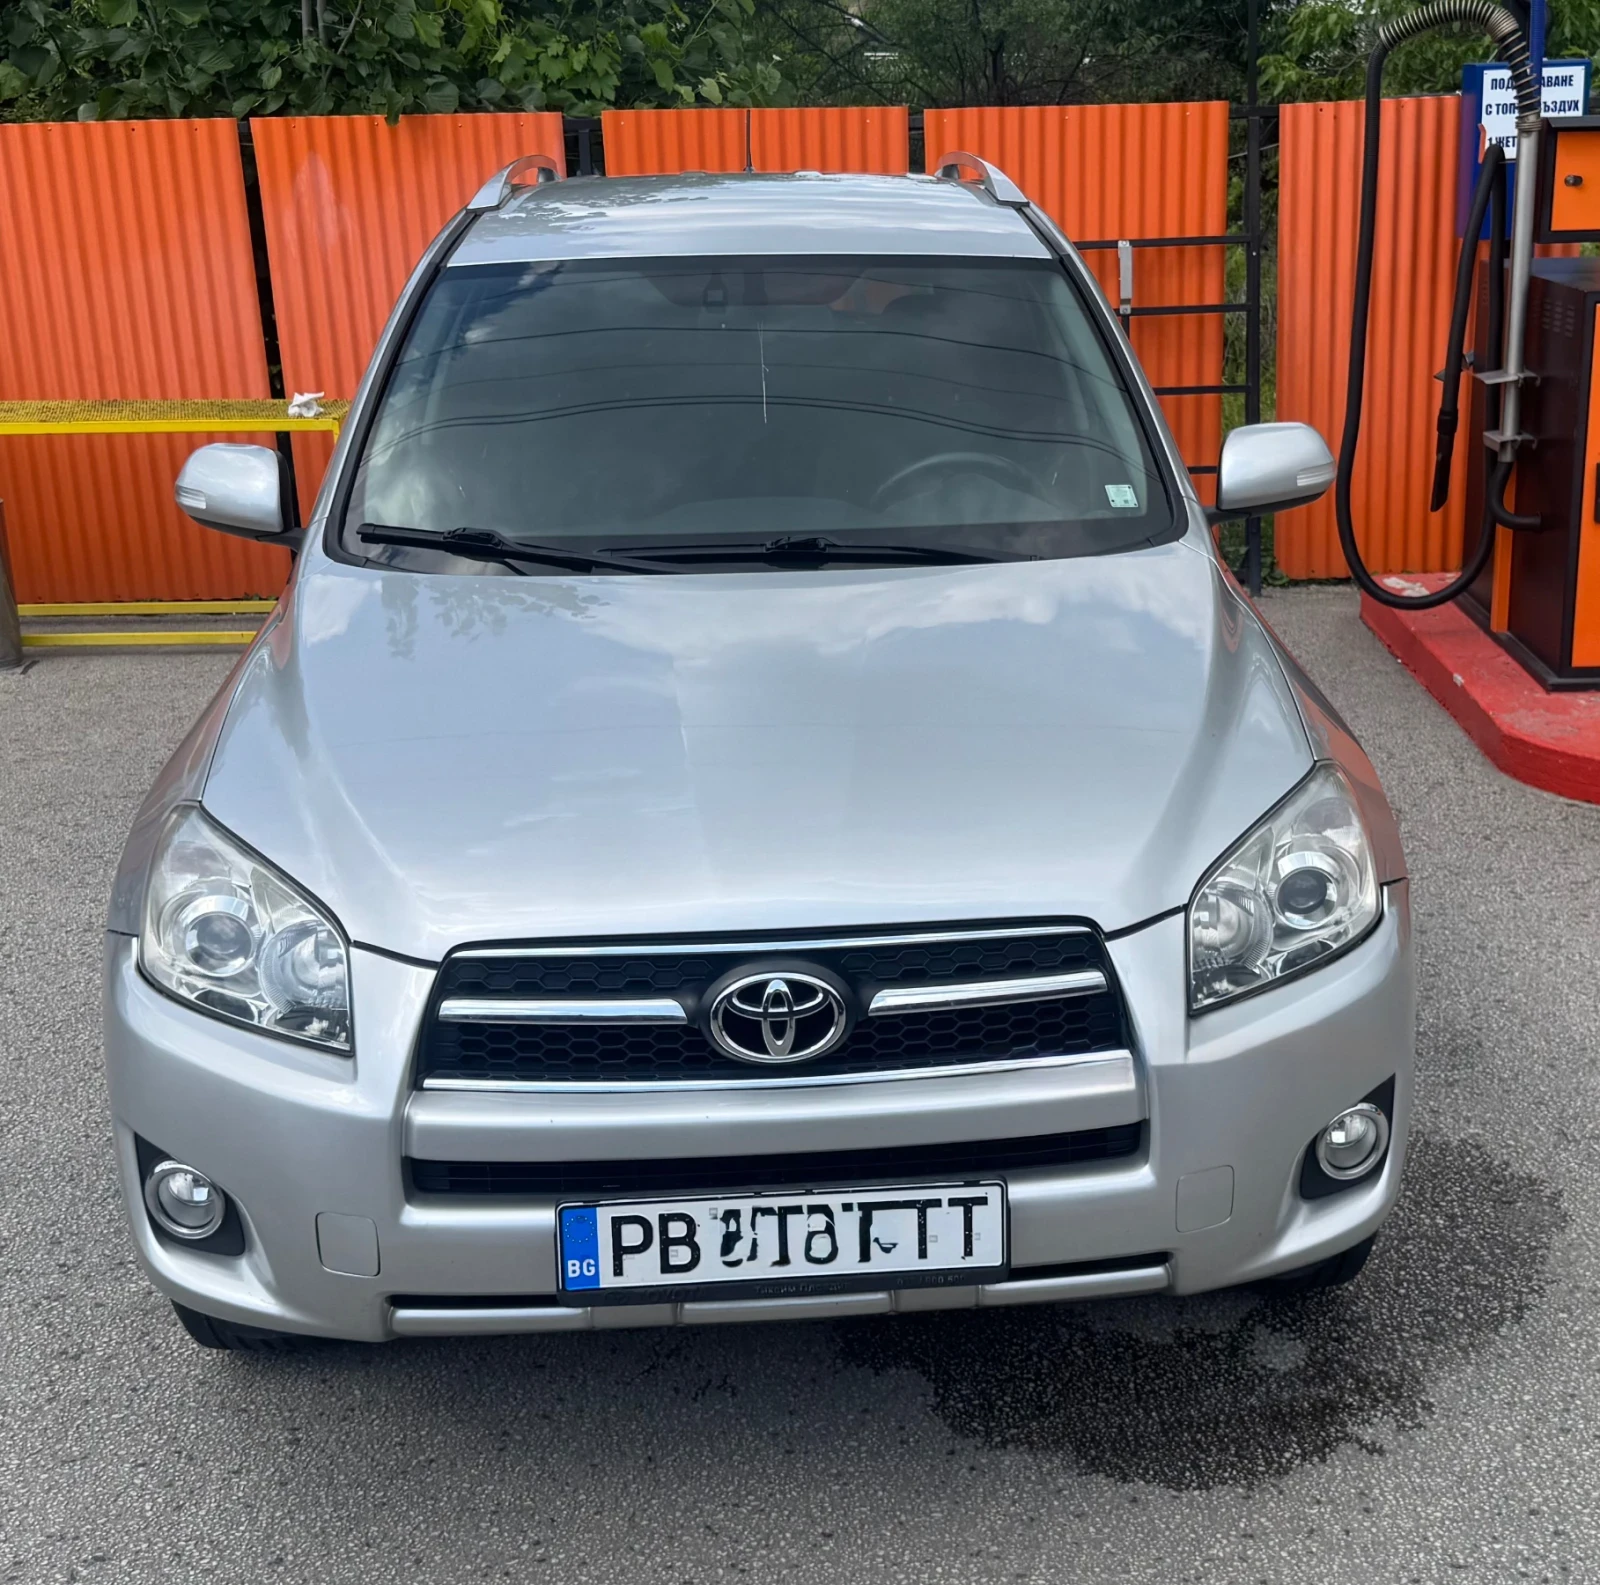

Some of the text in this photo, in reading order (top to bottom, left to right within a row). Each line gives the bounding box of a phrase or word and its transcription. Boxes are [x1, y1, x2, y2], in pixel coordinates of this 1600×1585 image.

[1490, 75, 1574, 91] ПОДАВАНЕ
[1485, 103, 1493, 116] С
[1537, 99, 1580, 114] ЪЗДУХ
[567, 1258, 596, 1278] BG
